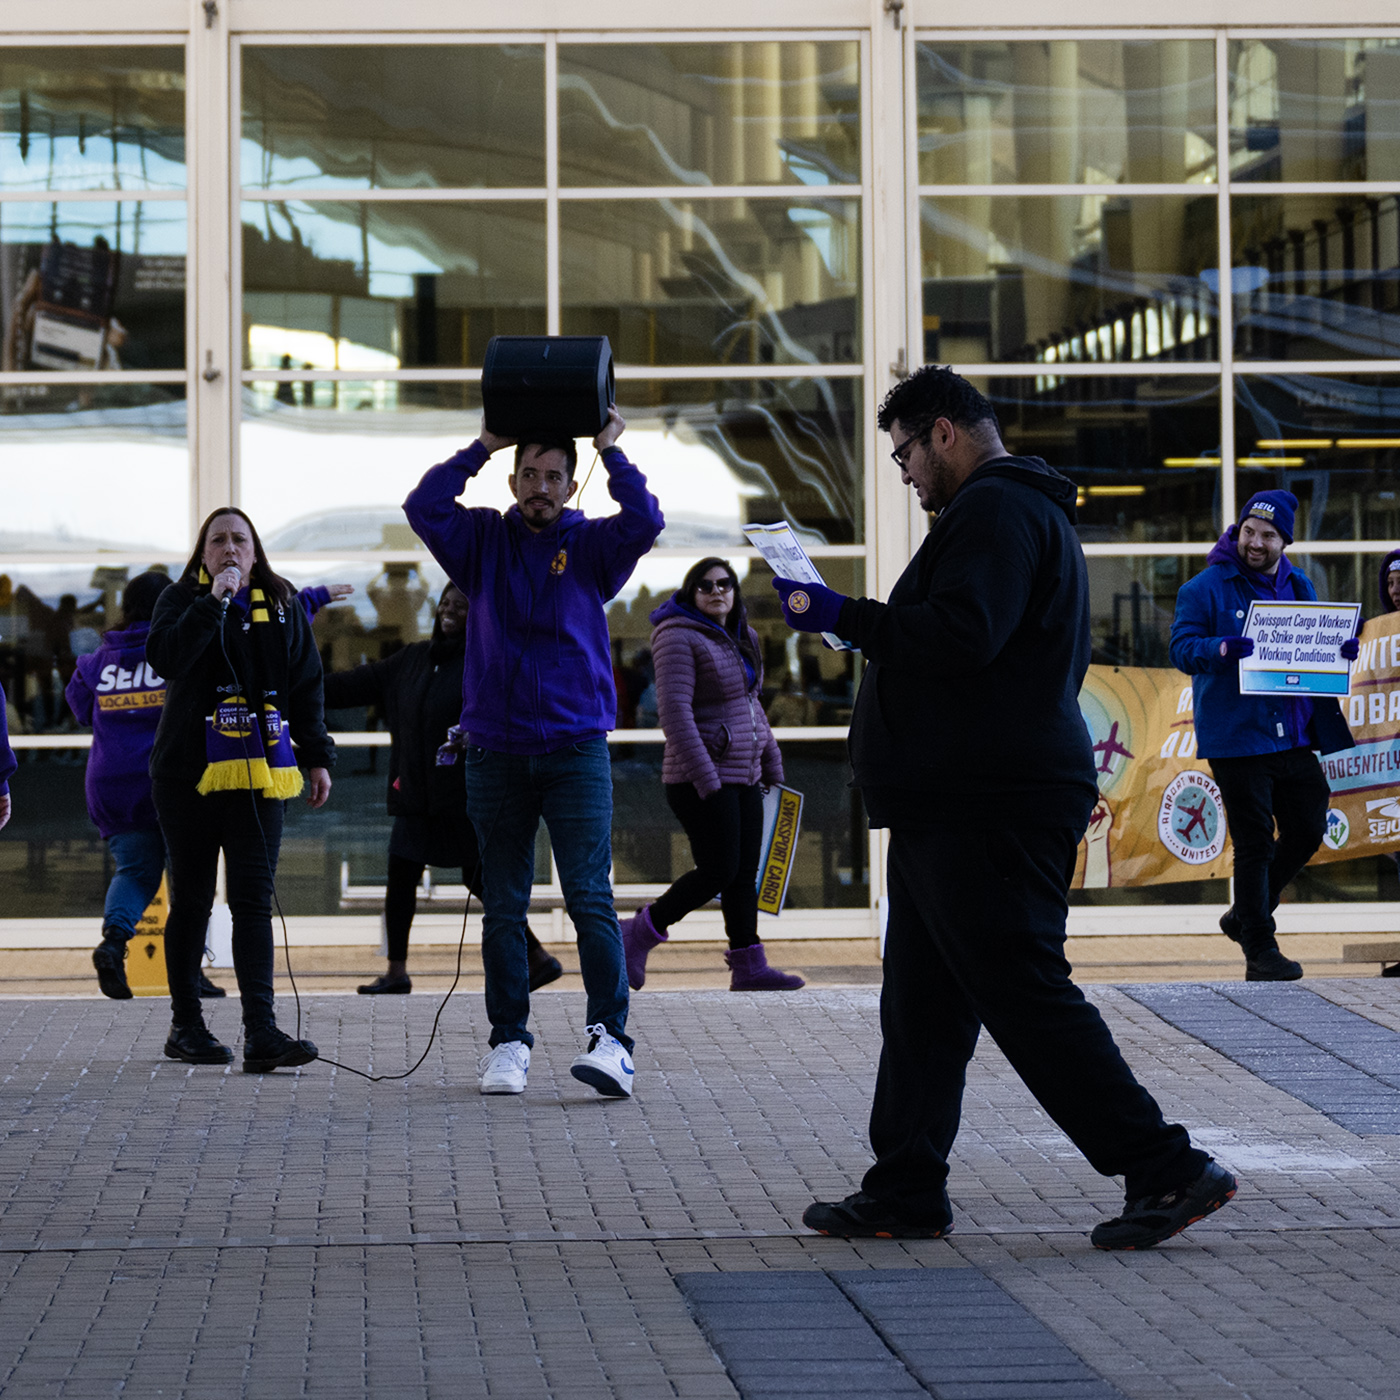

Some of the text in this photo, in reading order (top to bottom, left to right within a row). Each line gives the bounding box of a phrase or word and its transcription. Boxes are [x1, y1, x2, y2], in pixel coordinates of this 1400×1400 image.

[1252, 502, 1276, 513] SEIU
[1253, 613, 1352, 630] Swissport Cargo Workers
[1257, 630, 1344, 646] On Strike over Unsafe
[1259, 646, 1336, 664] Working Conditions
[96, 662, 165, 691] SEIU
[100, 695, 139, 708] LOCAL
[220, 716, 251, 725] UNTE
[1162, 774, 1222, 825] AIRPORT WORKE
[762, 799, 796, 905] SWISSPORT CARGO
[1181, 845, 1218, 860] UNITED
